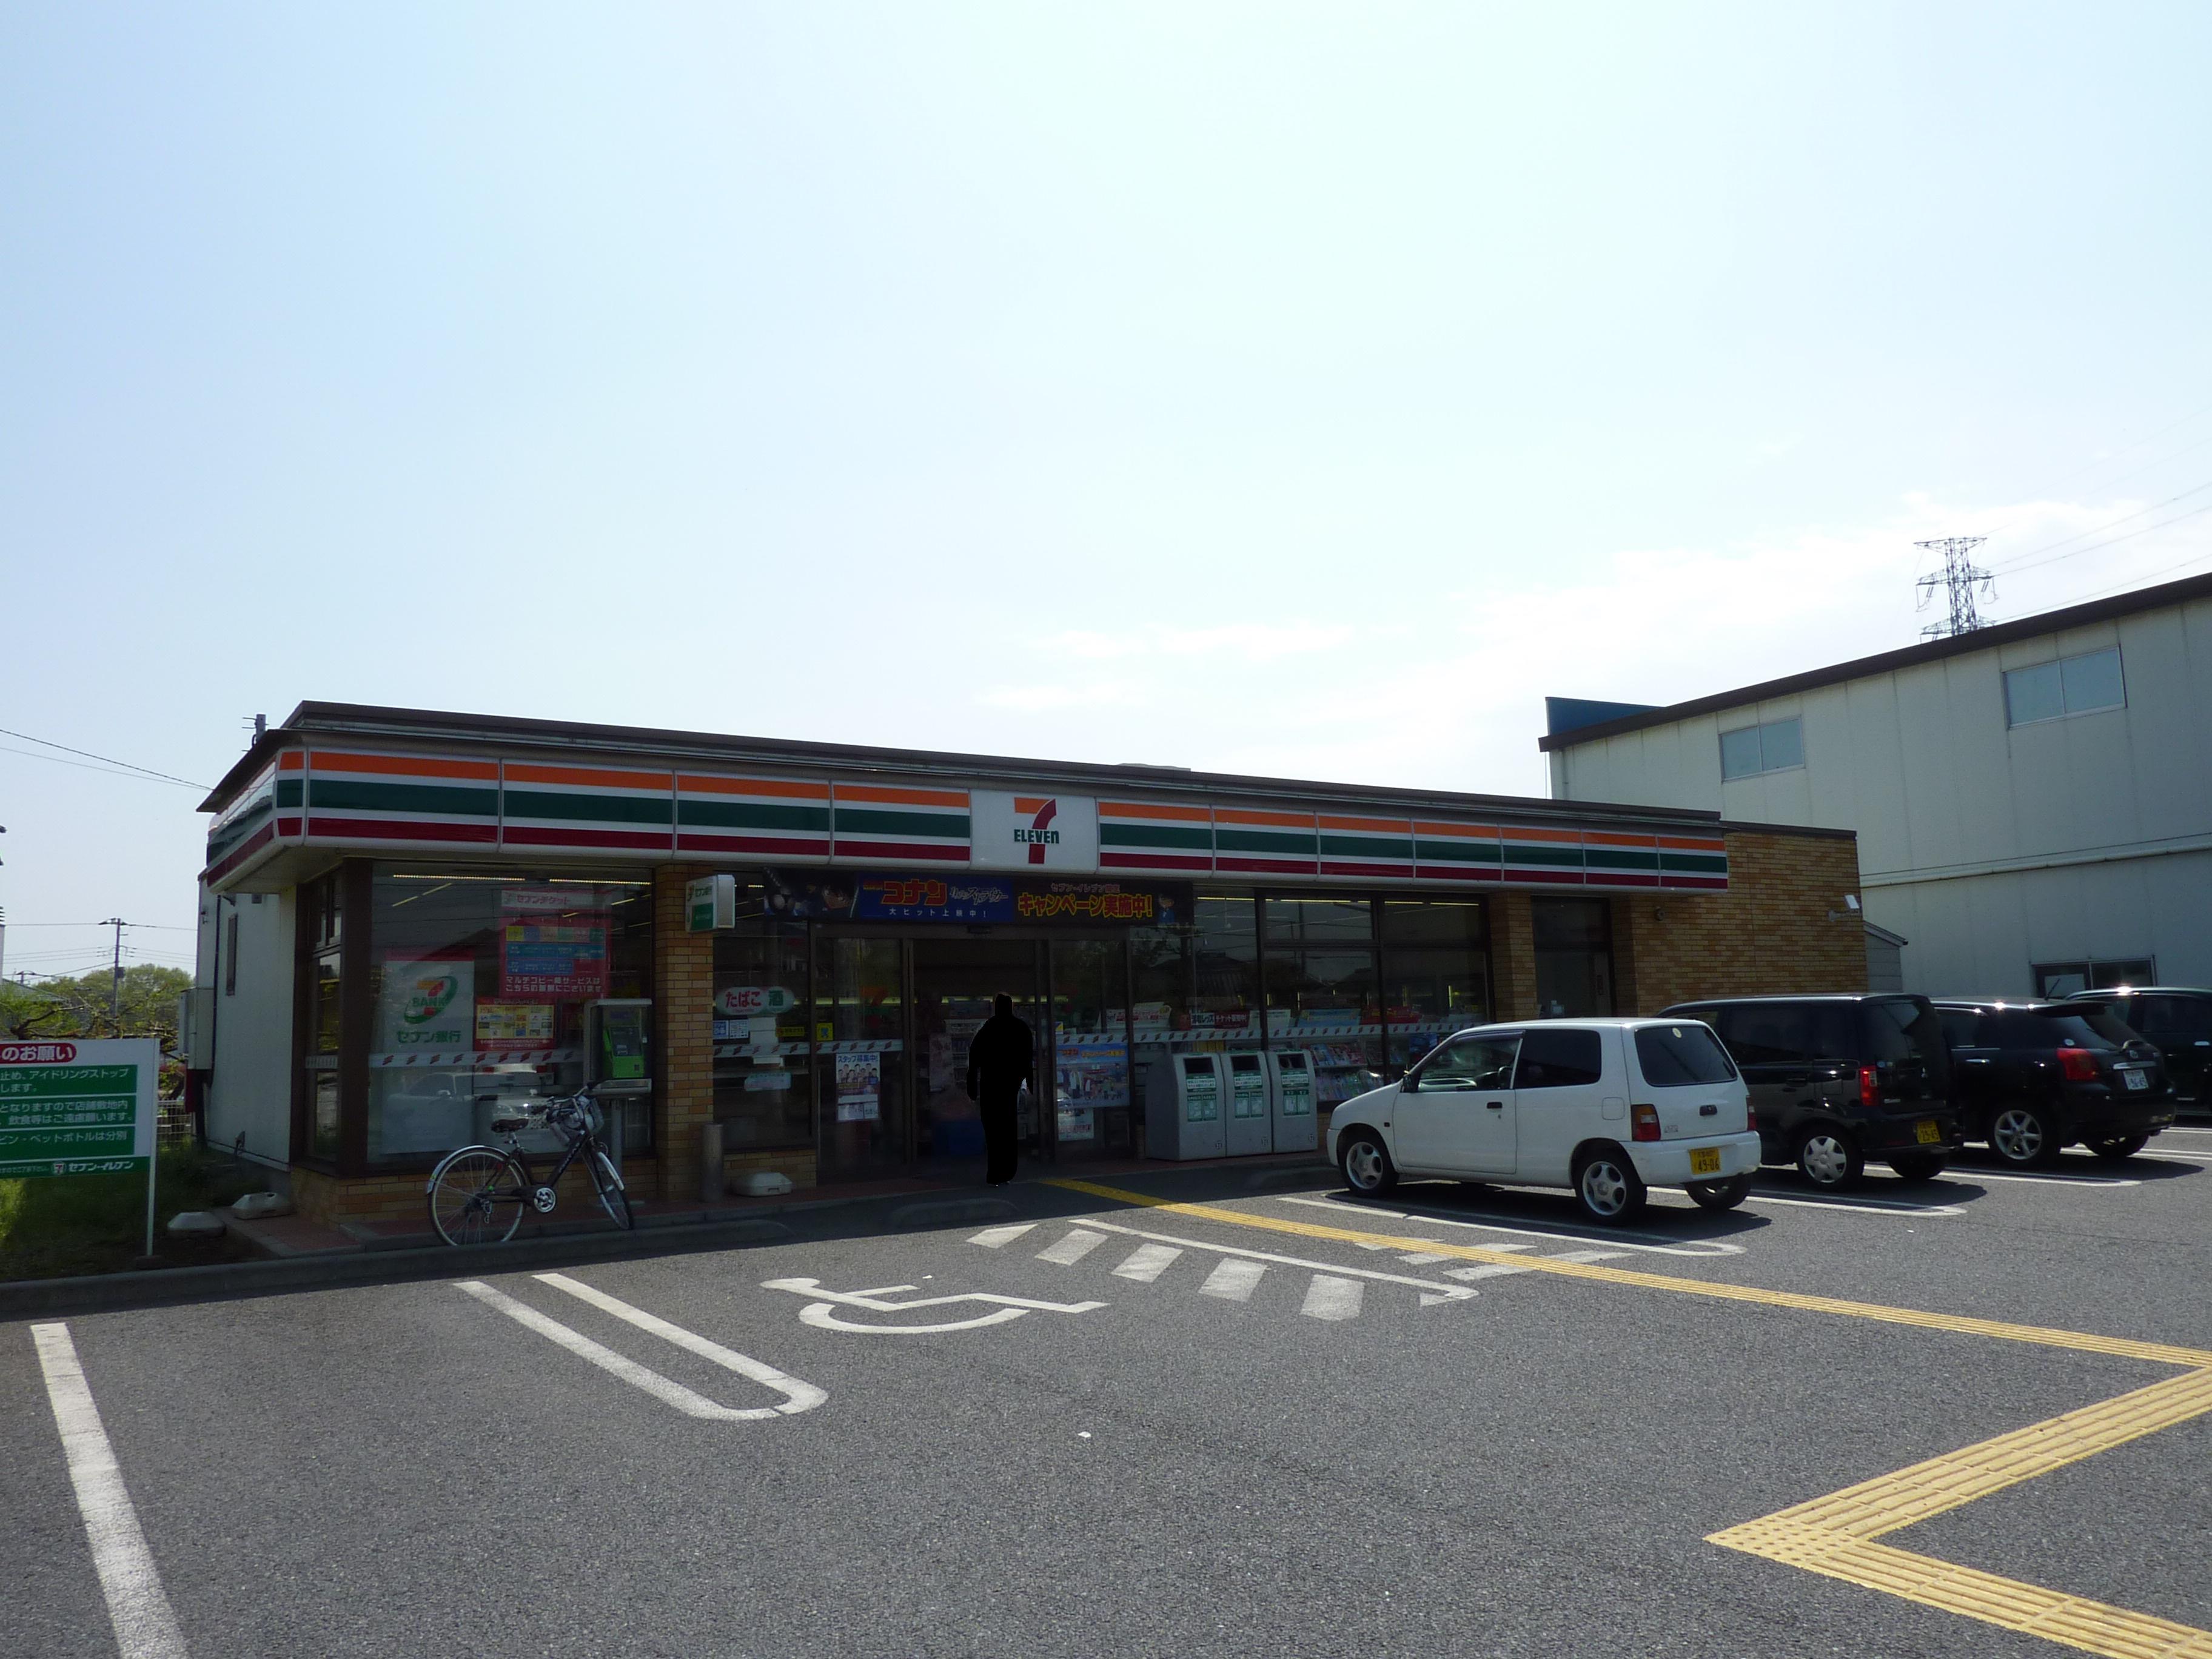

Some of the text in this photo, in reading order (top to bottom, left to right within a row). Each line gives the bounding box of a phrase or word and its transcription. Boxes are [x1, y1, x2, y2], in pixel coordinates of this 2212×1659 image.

[881, 879, 948, 906] コナン
[1018, 892, 1153, 919] キャンペーン実施中!
[412, 997, 446, 1007] BANK
[725, 990, 783, 1008] たばこ 酒
[397, 1031, 461, 1044] セブン銀行
[0, 1045, 73, 1061] のお願い
